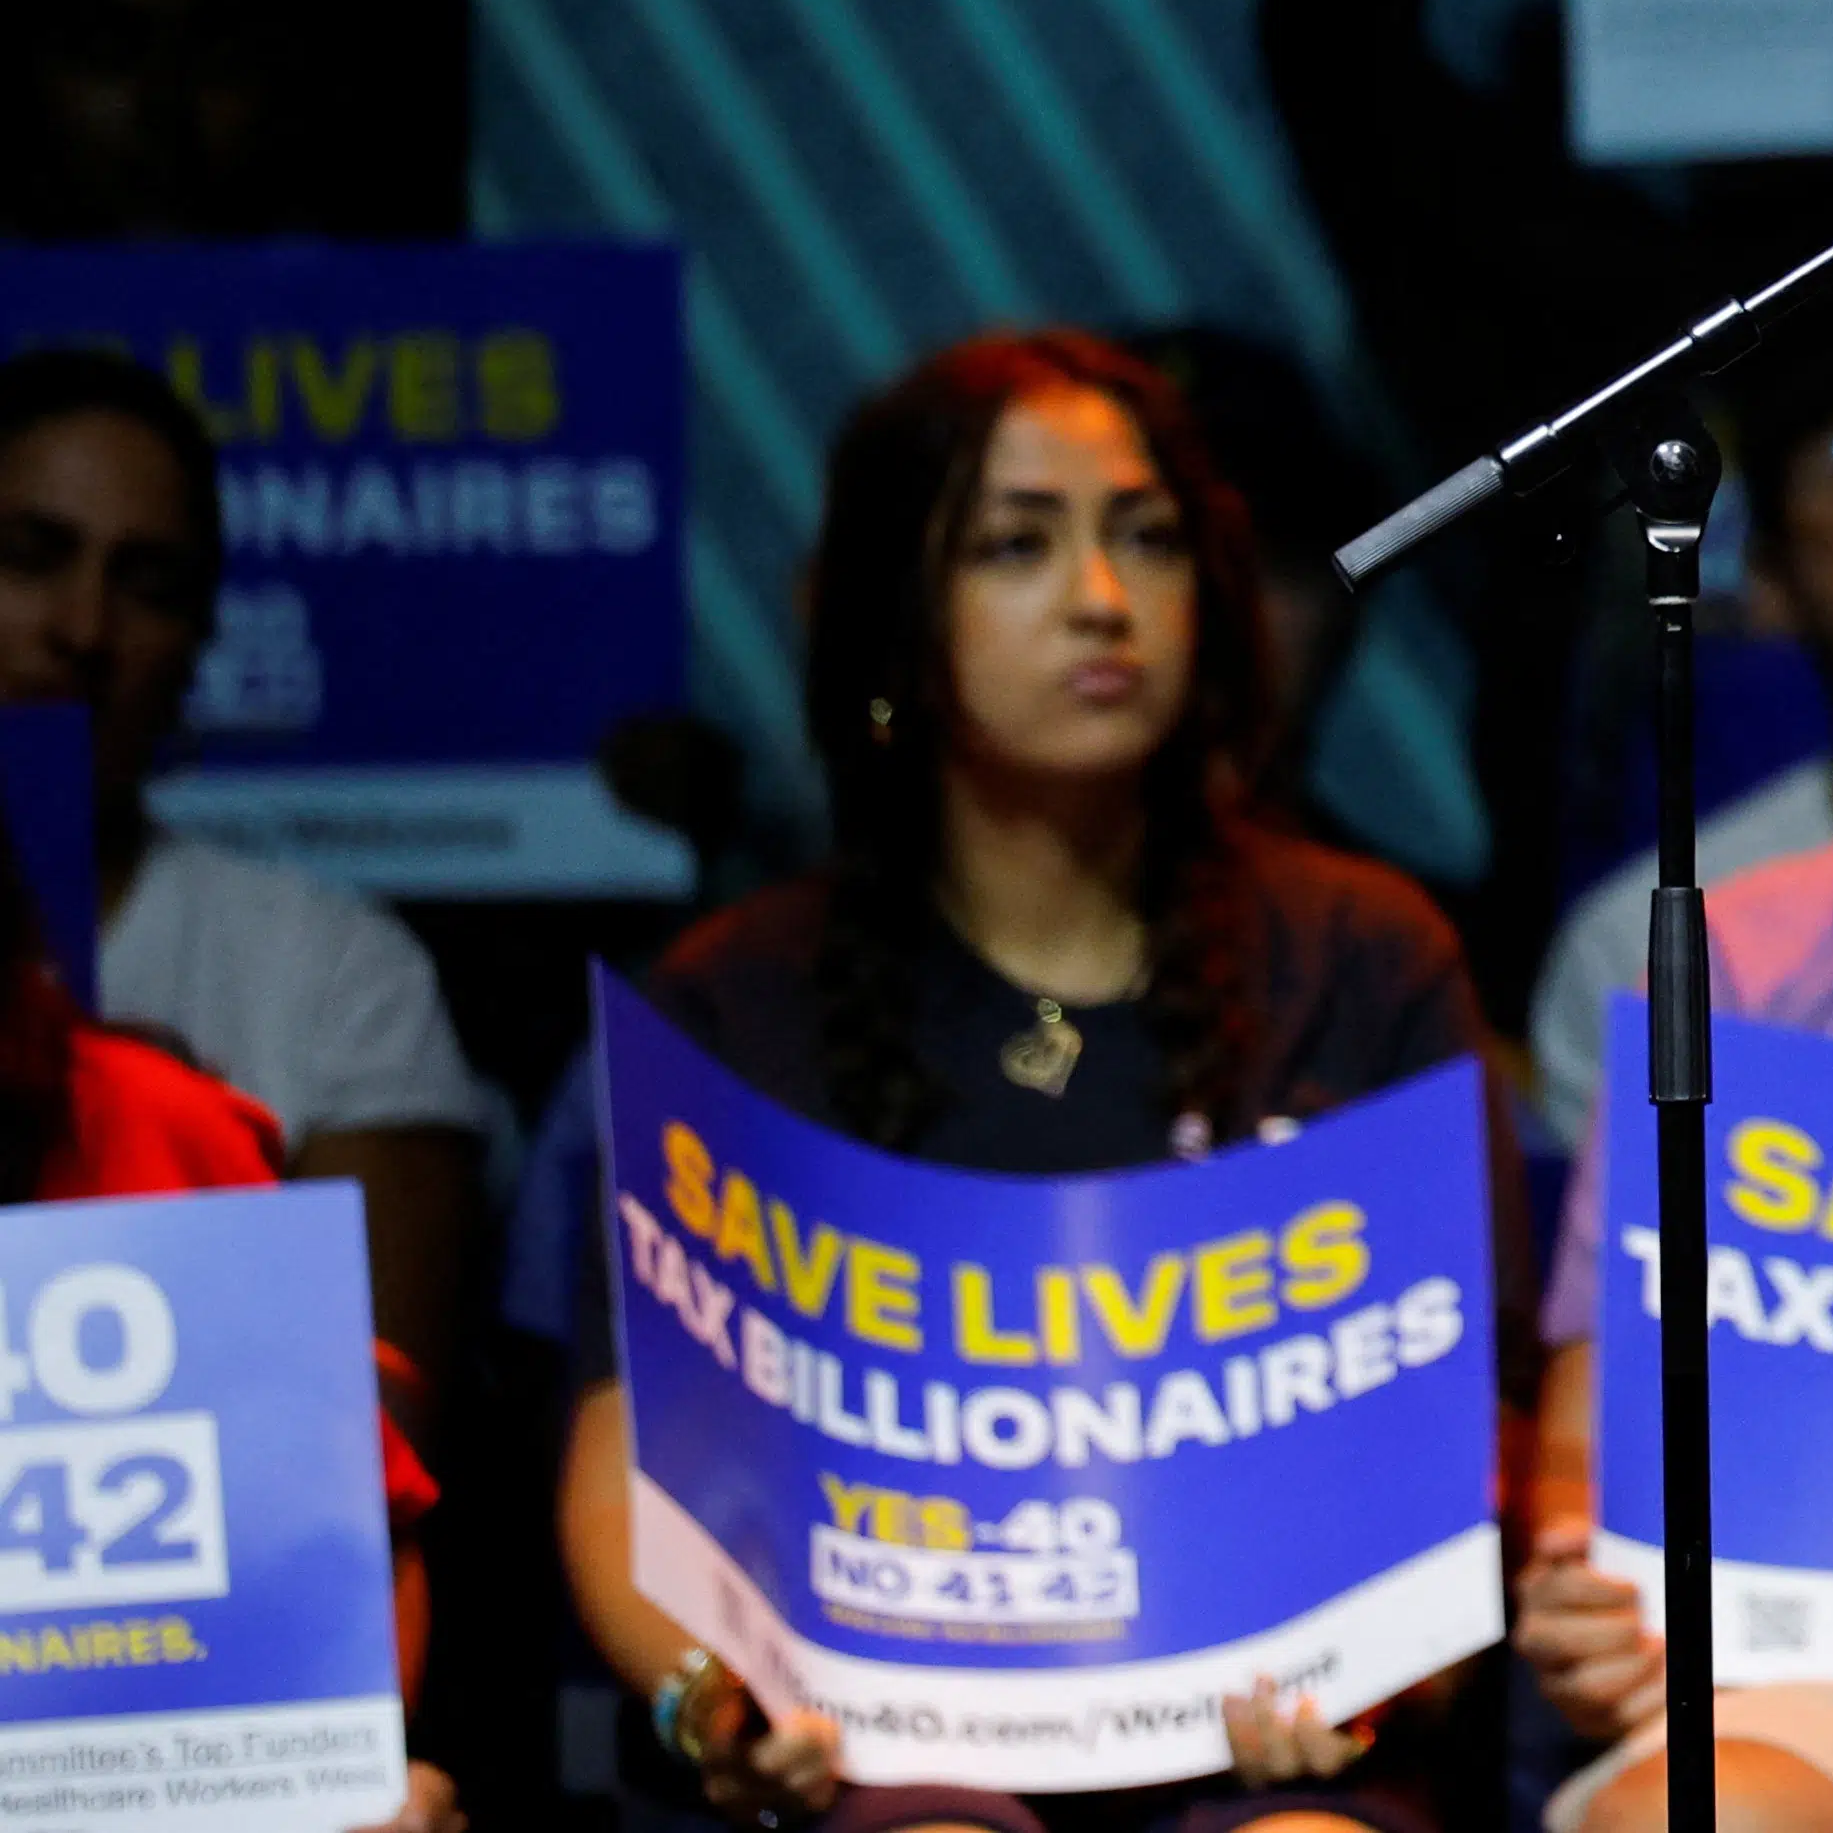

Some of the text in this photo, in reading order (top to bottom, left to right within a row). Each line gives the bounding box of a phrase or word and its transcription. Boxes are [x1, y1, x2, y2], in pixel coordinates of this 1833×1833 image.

[167, 327, 562, 443] LIVES
[663, 1120, 1370, 1367] SAVE LIVES
[619, 1191, 1464, 1471] TAX BILLIONAIRES
[0, 1454, 200, 1580] 42
[817, 1469, 1123, 1556] YES 40
[830, 1548, 910, 1596] NO
[935, 1570, 1012, 1607] 41
